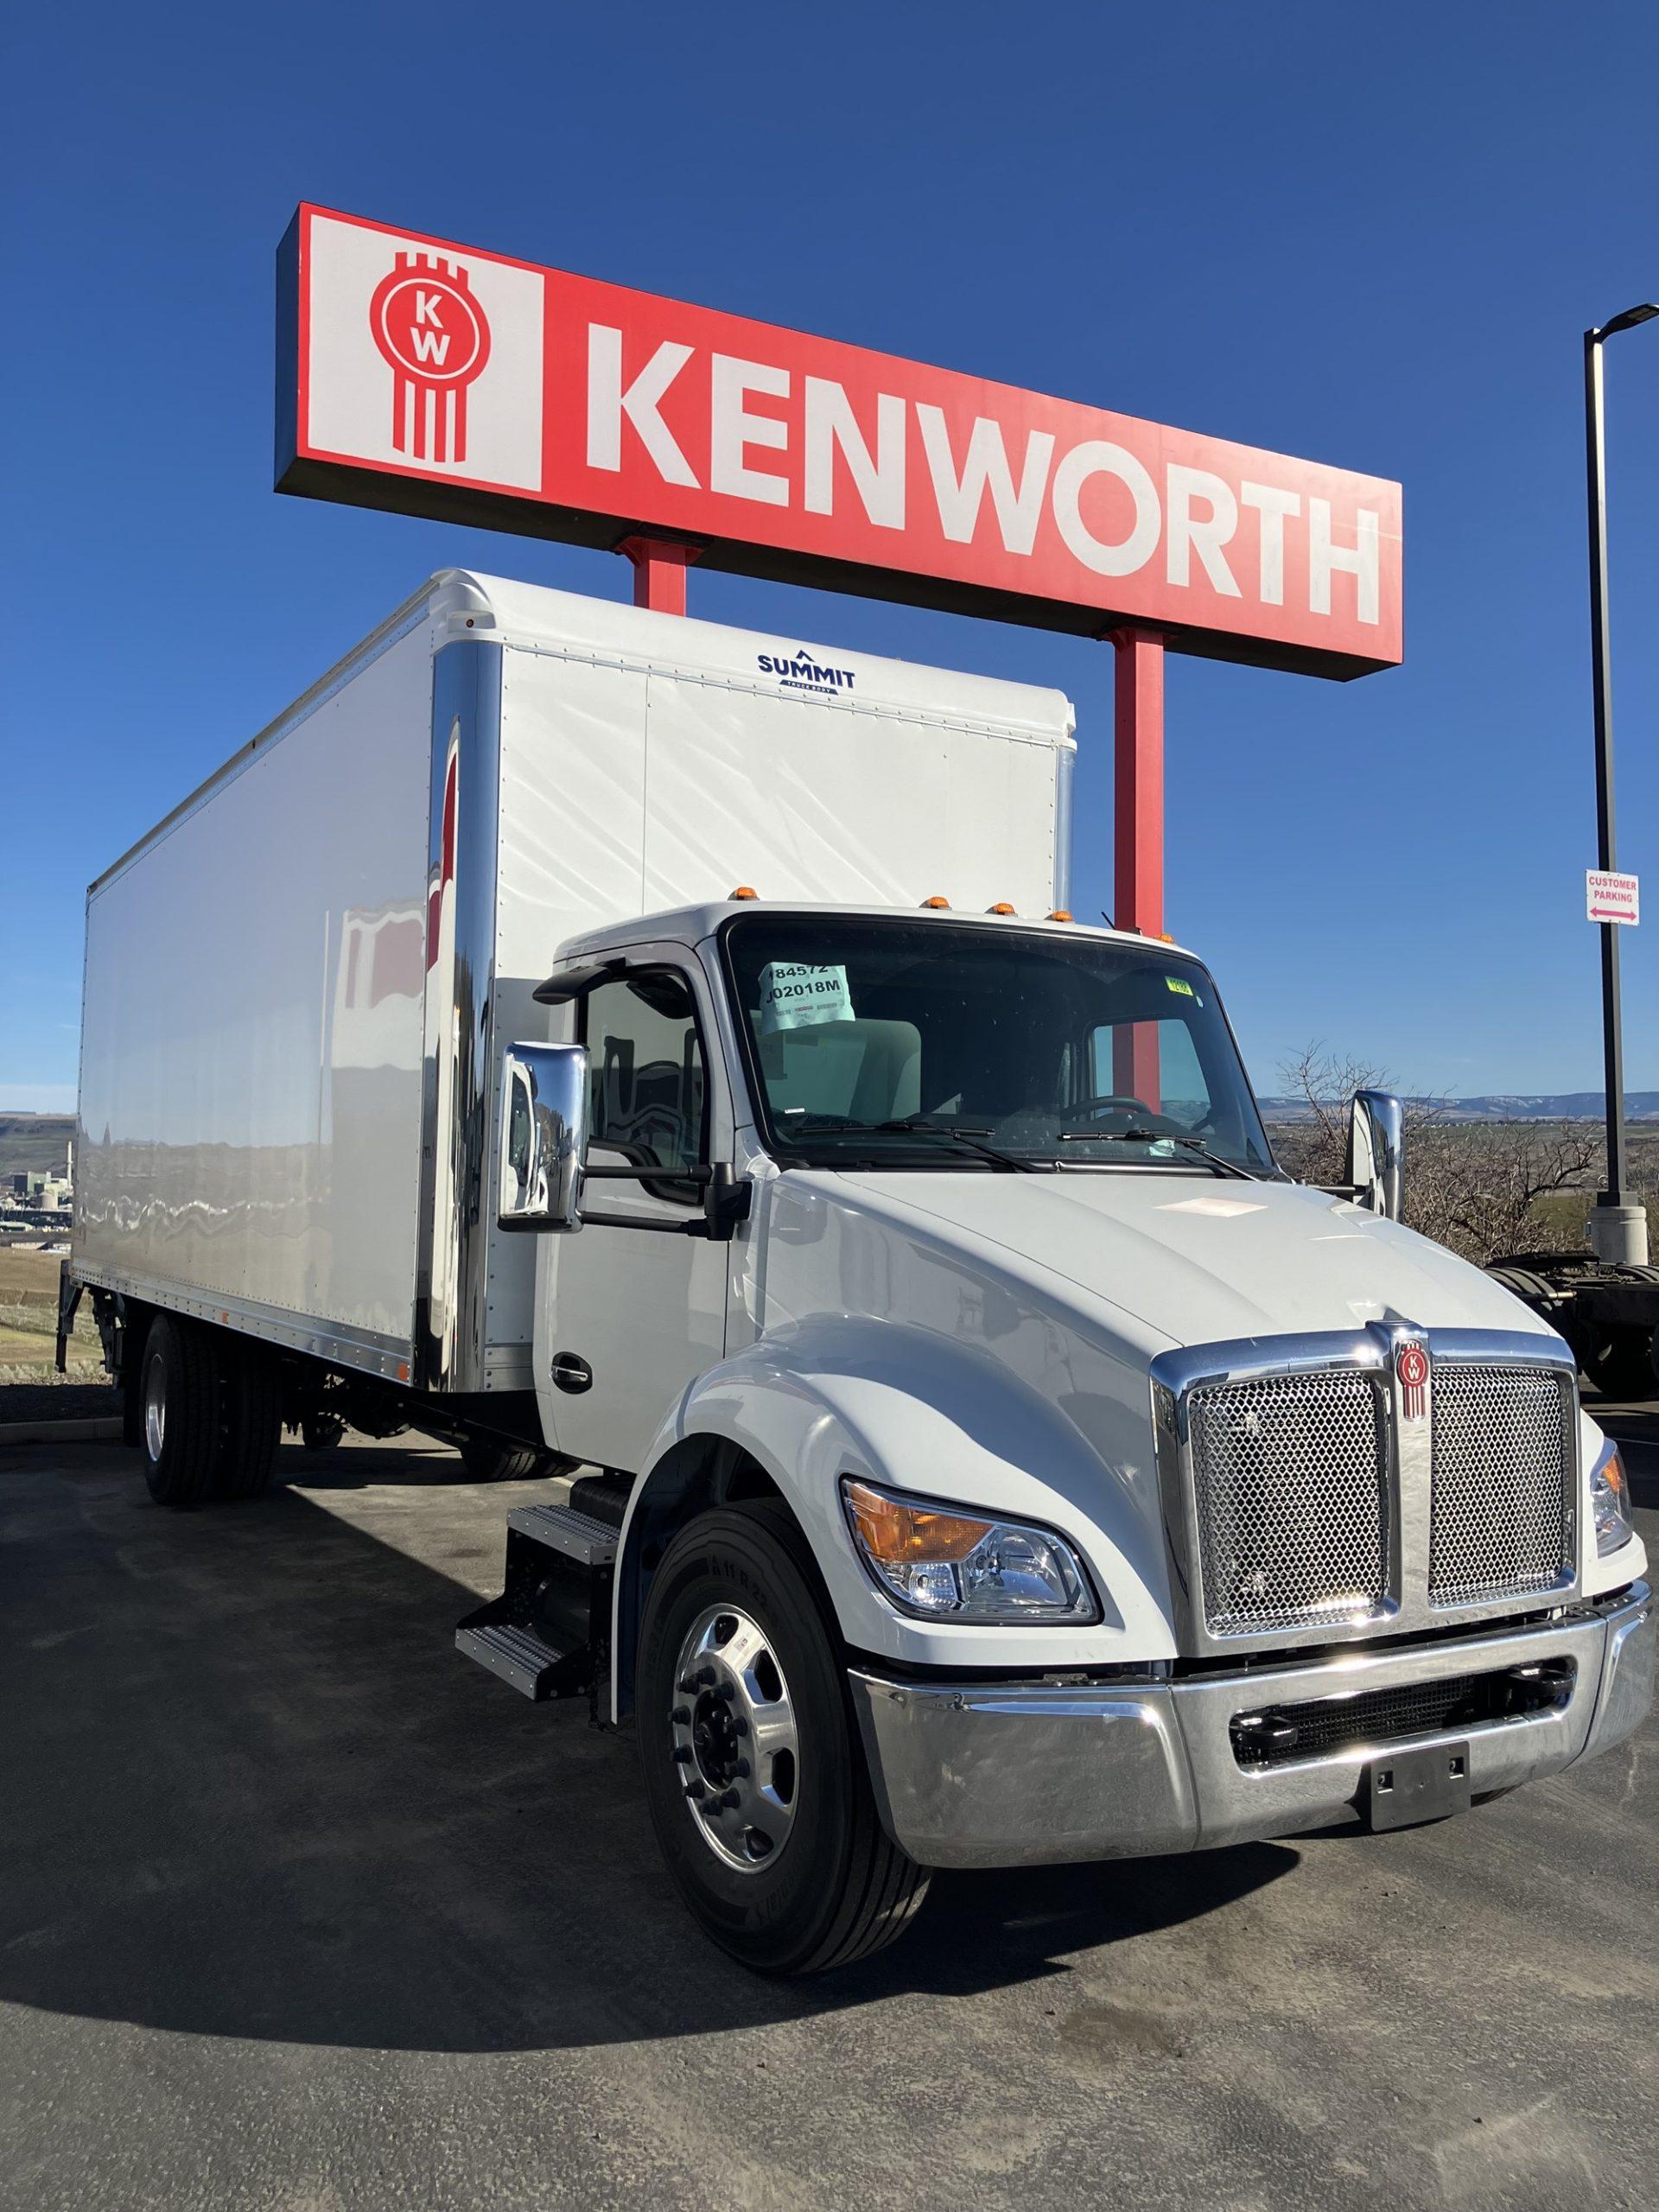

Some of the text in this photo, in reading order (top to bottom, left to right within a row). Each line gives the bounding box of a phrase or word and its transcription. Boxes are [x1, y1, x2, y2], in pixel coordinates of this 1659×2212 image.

[587, 321, 1379, 626] KENWORTH
[758, 655, 855, 689] SUMMIT
[787, 681, 810, 690] TRUCK
[1588, 876, 1637, 890] CUSTOMER
[1594, 891, 1633, 902] PARKING
[766, 980, 841, 1003] J02018M
